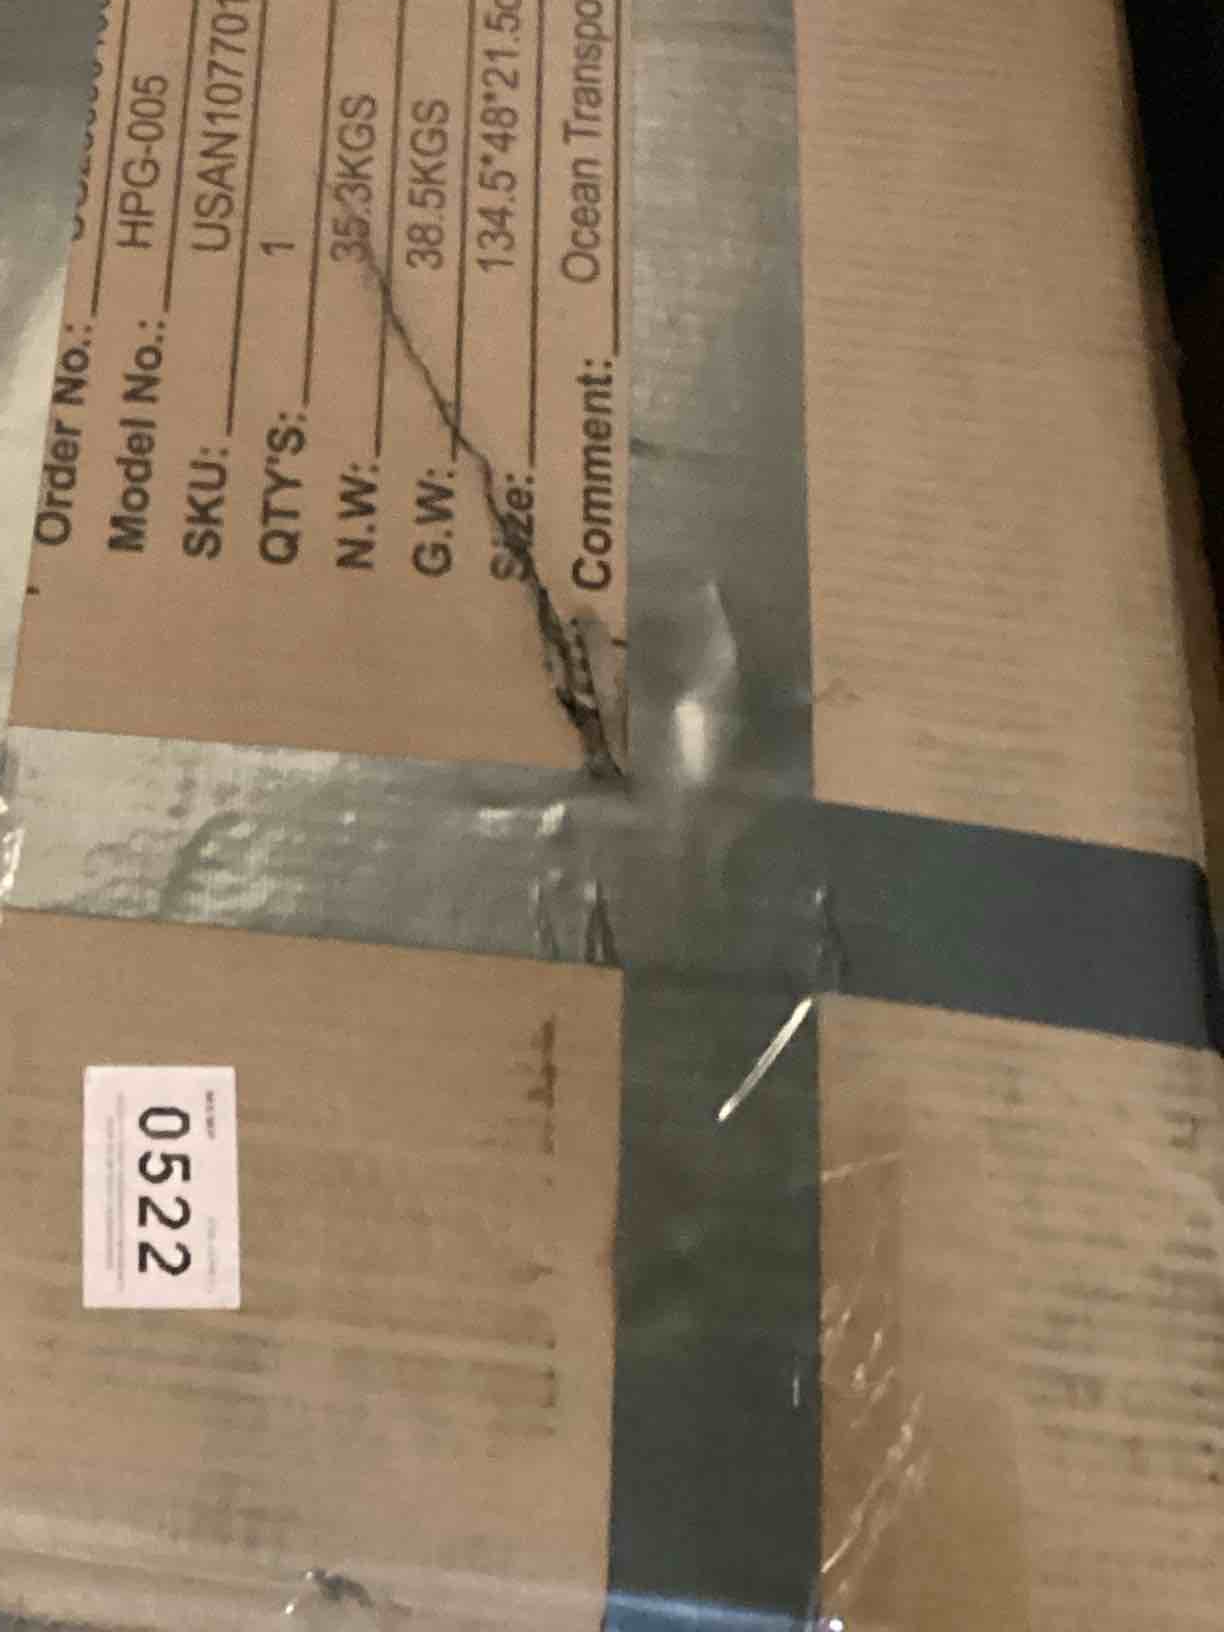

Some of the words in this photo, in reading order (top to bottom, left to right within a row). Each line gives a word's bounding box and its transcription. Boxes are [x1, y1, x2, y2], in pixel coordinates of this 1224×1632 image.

[116, 74, 168, 250] HPG-005
[328, 93, 377, 265] 35.3KGS
[404, 98, 449, 271] 38.5KGS
[560, 158, 602, 284] Ocean
[260, 241, 294, 257] 1
[52, 324, 91, 407] No.:
[121, 321, 165, 404] No.:
[33, 420, 82, 547] Order
[106, 419, 157, 554] Model
[182, 447, 228, 561] SKU:
[258, 413, 305, 566] QTY'S:
[335, 464, 379, 569] N.W:
[411, 469, 454, 577] G.W:
[571, 358, 613, 592] Comment:
[138, 1106, 192, 1277] 0522
